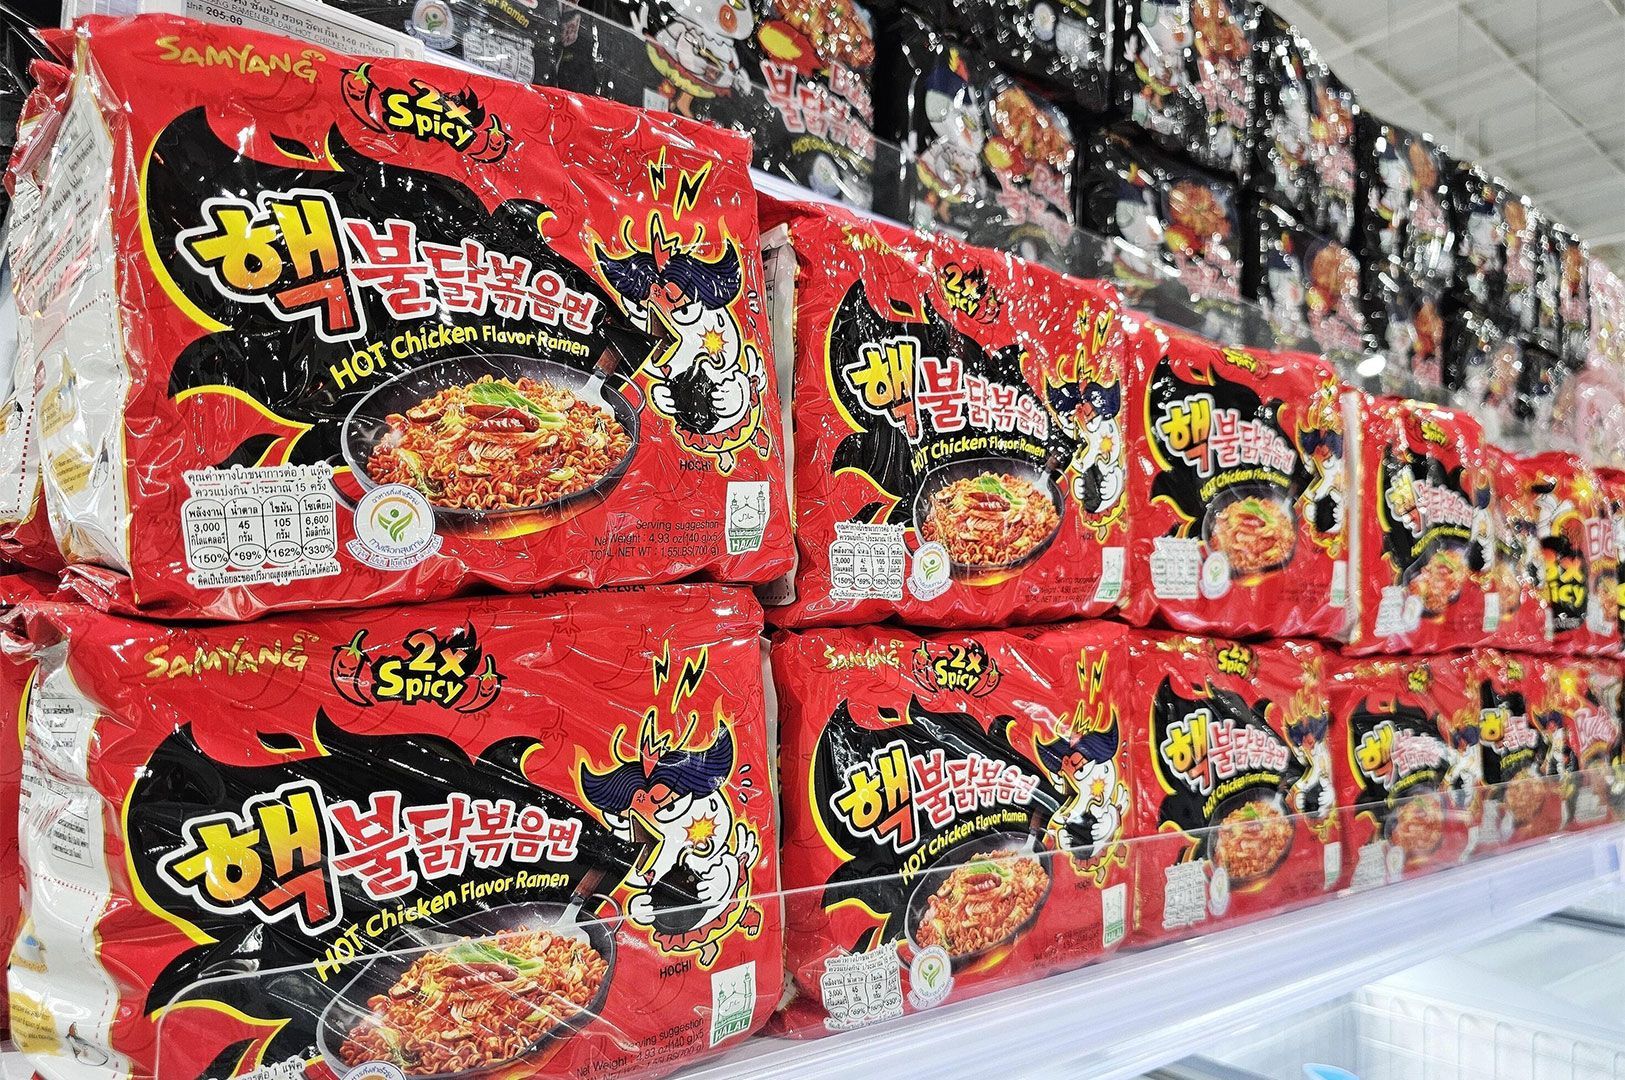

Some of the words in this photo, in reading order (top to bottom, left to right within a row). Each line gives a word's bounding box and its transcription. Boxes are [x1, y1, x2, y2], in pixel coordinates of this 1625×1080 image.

[206, 6, 242, 26] 205.00
[232, 5, 260, 20] RAMEN
[295, 26, 311, 38] HOT
[500, 1, 529, 28] Ramen
[155, 35, 319, 83] SAMYANG
[387, 94, 474, 146] Spicy
[329, 340, 388, 390] HOT
[390, 325, 478, 361] Chicken
[482, 328, 536, 347] Flavor
[537, 331, 590, 357] Ramen
[910, 445, 929, 475] HOT
[930, 436, 987, 459] Chicken
[301, 468, 306, 477] 1
[295, 482, 306, 492] 15
[189, 503, 222, 518] พลังงาน
[305, 515, 329, 526] 6,600
[194, 522, 220, 533] 3,000
[238, 520, 250, 530] 45
[274, 518, 291, 527] 105
[636, 519, 671, 531] Serving
[675, 521, 718, 531] suggestion
[238, 531, 253, 542] กรัม
[276, 529, 290, 540] กรัม
[649, 532, 670, 543] 4.93
[618, 547, 636, 557] NET
[638, 547, 651, 556] WT
[144, 636, 310, 679] SAMYANG
[376, 661, 463, 705] Spicy
[934, 660, 980, 691] Spicy
[899, 844, 927, 885] HOT
[928, 820, 975, 856] Chicken
[976, 812, 1001, 830] Flavor
[1002, 809, 1028, 822] Ramen
[312, 928, 369, 983] HOT
[365, 890, 457, 937] Chicken
[461, 875, 515, 902] Flavor
[516, 870, 570, 889] Ramen
[659, 960, 692, 978] HOCHI
[659, 1017, 704, 1041] suggestion
[715, 1019, 749, 1043] HALAL
[577, 1066, 591, 1077] Net
[592, 1056, 628, 1071] Weight
